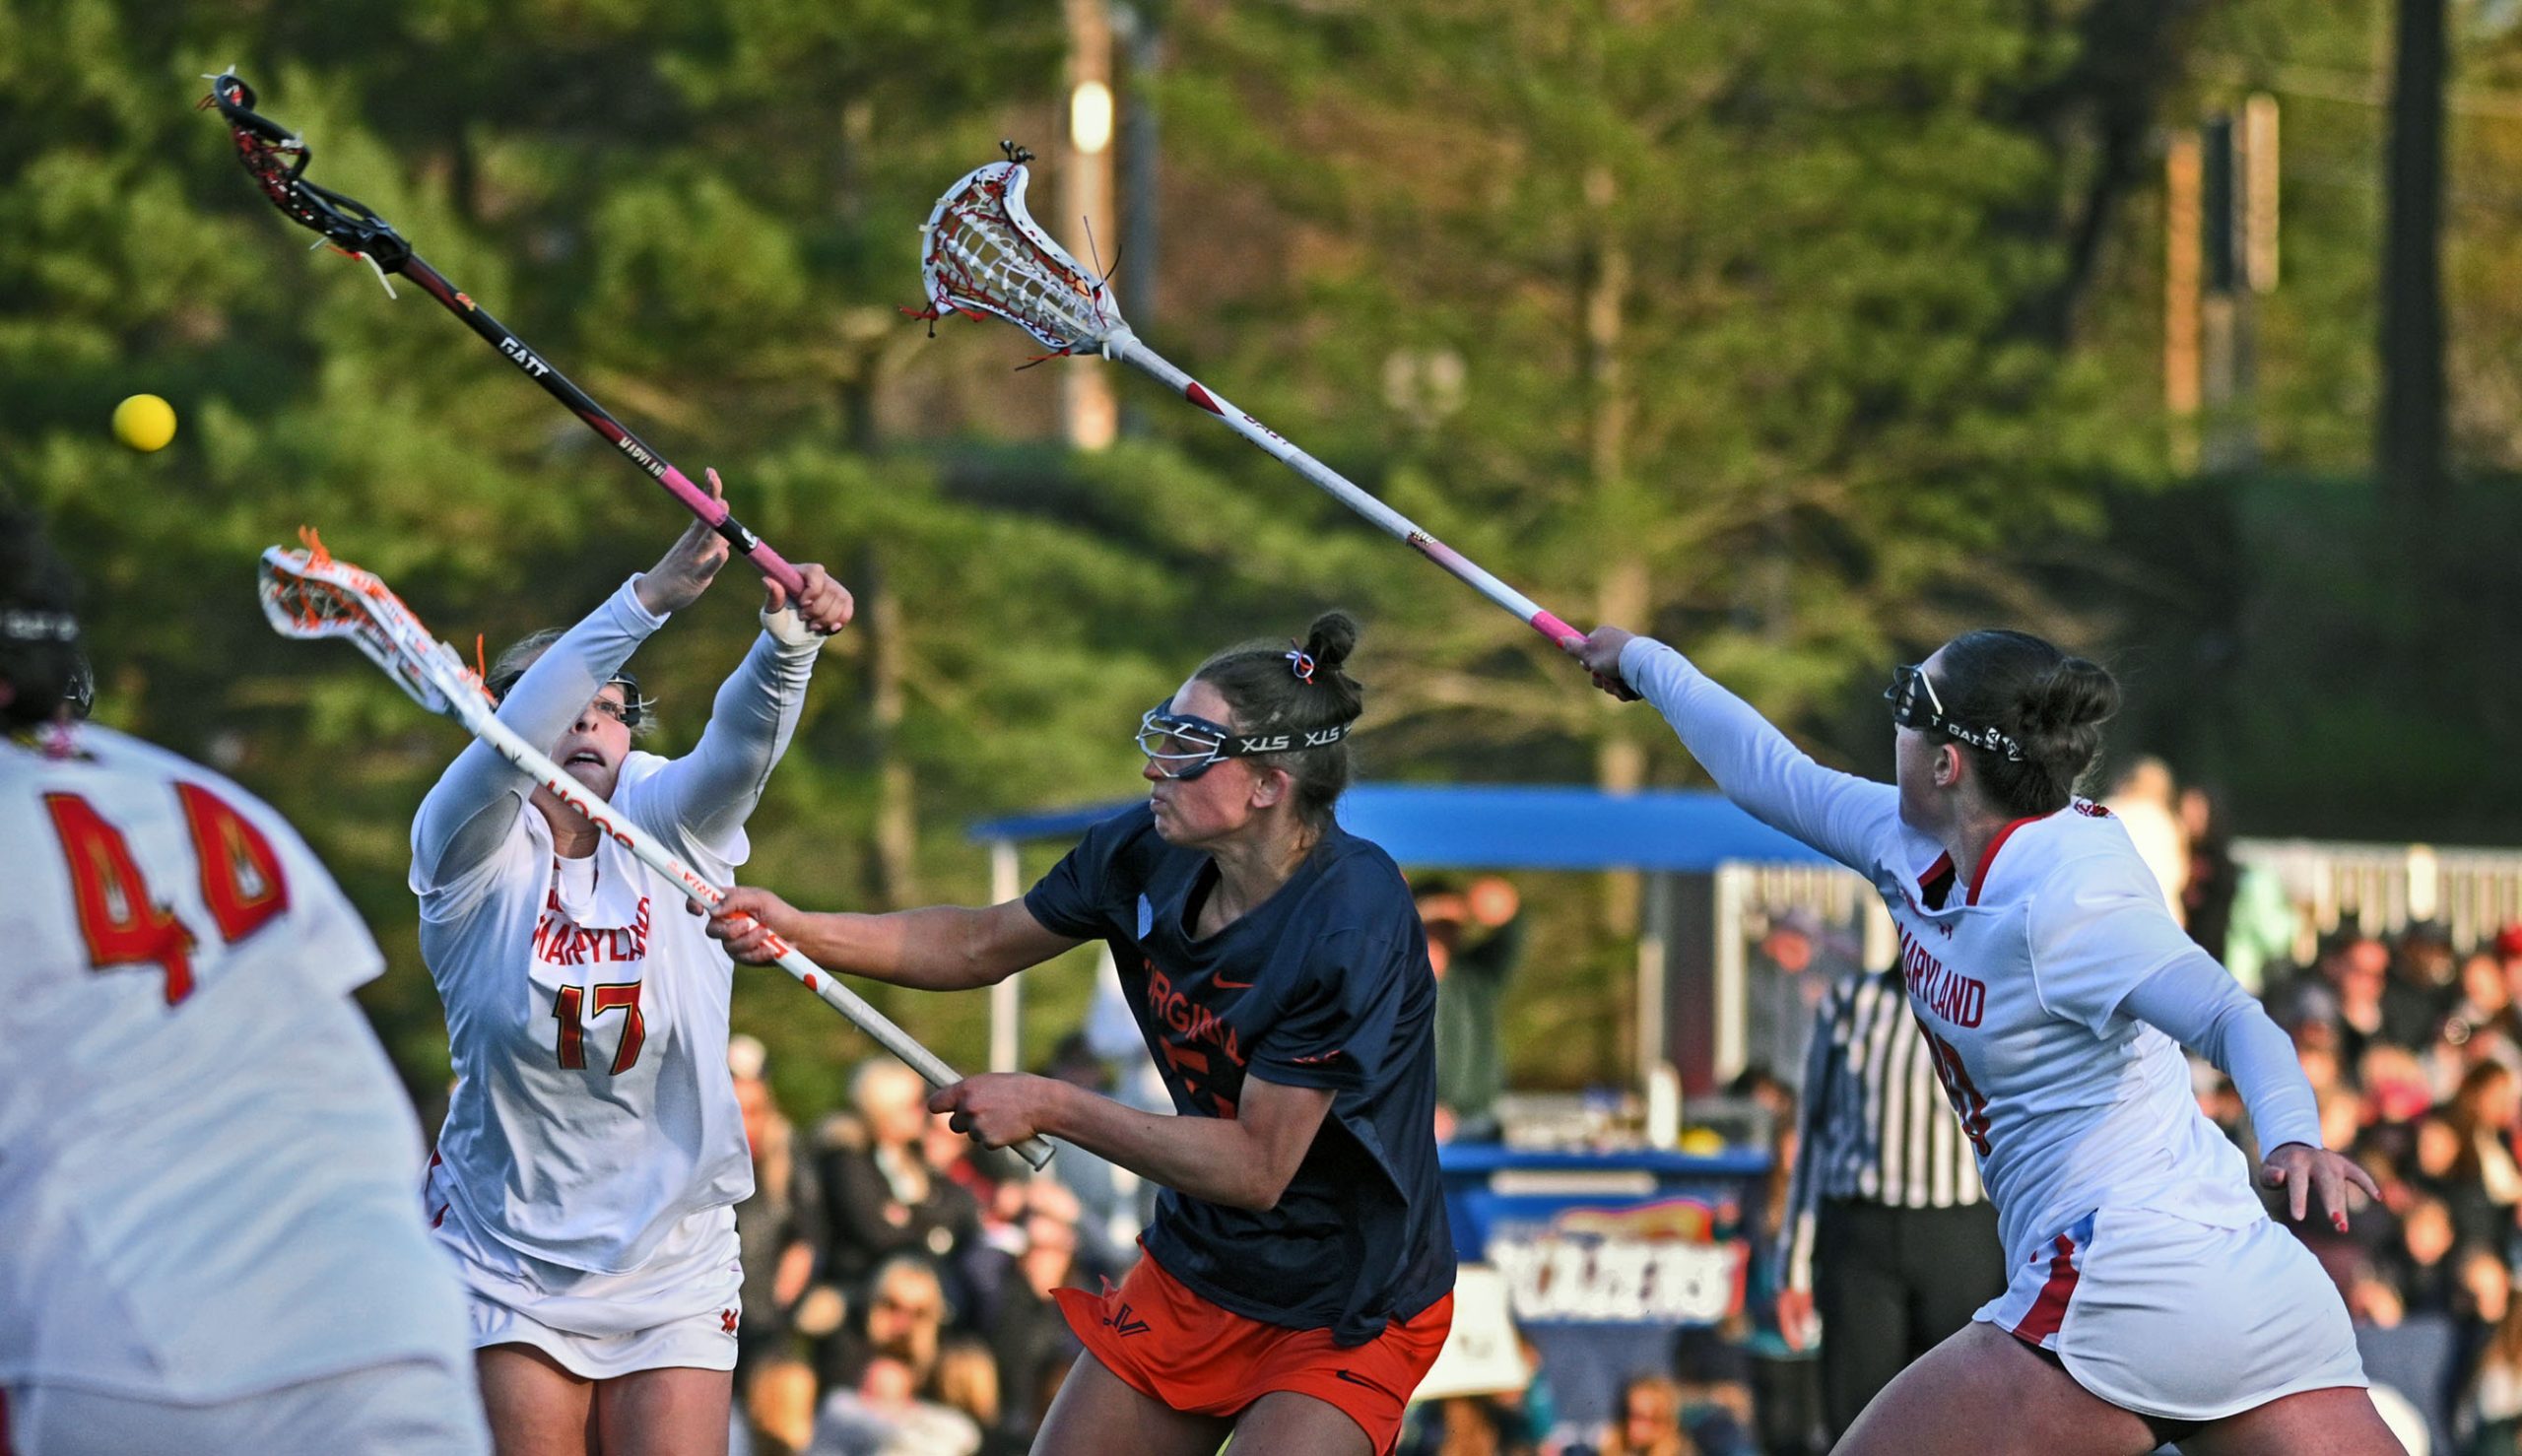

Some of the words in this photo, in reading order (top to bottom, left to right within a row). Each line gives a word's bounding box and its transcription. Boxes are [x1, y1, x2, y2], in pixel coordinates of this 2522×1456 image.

[1241, 736, 1290, 752] STX
[1305, 726, 1340, 746] STX
[1897, 921, 1986, 1029] MARYLAND
[552, 979, 646, 1077] 17
